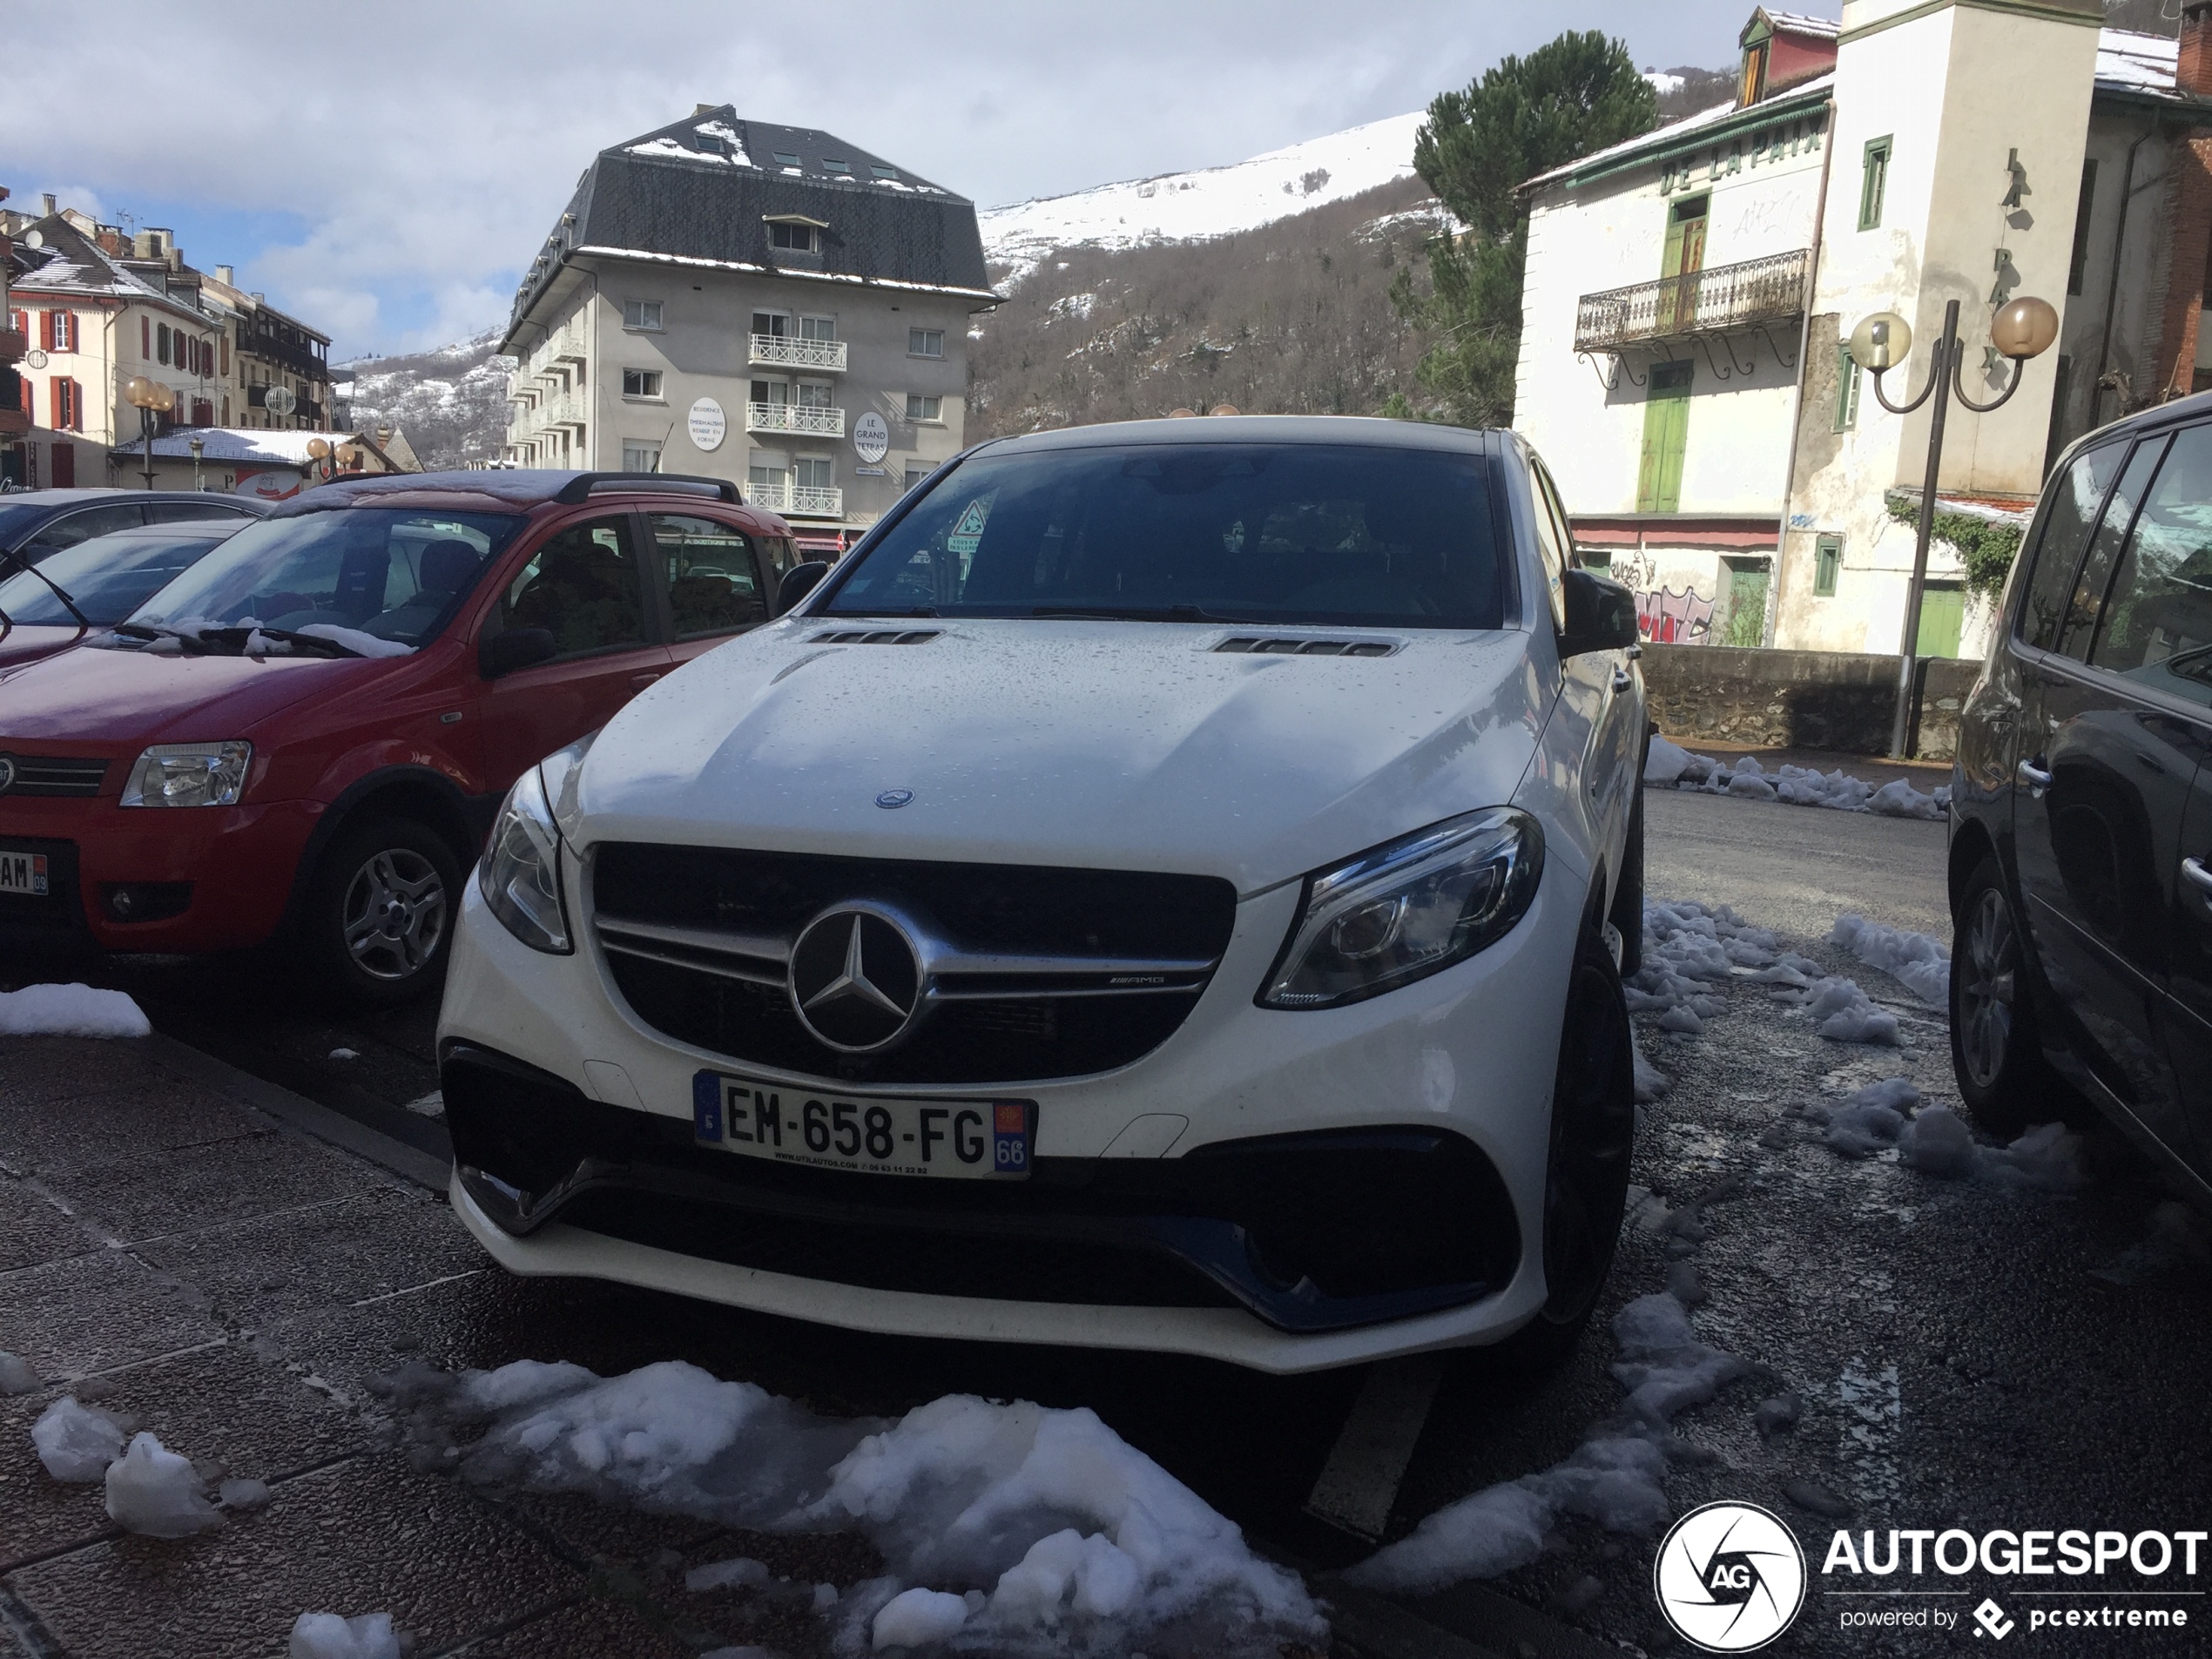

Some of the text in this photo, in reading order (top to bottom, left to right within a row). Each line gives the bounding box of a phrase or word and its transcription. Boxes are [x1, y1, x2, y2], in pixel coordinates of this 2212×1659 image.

[1660, 115, 1823, 197] DE LA PAIX
[1983, 147, 2021, 370] LA PAX
[867, 419, 875, 428] LE
[856, 430, 887, 440] GRAND
[856, 442, 886, 452] TETRAS
[34, 875, 46, 890] 09
[726, 1086, 985, 1163] EM-658-FG
[774, 1151, 859, 1170] WWW.UTILAUTOS.COM
[996, 1140, 1024, 1164] 66
